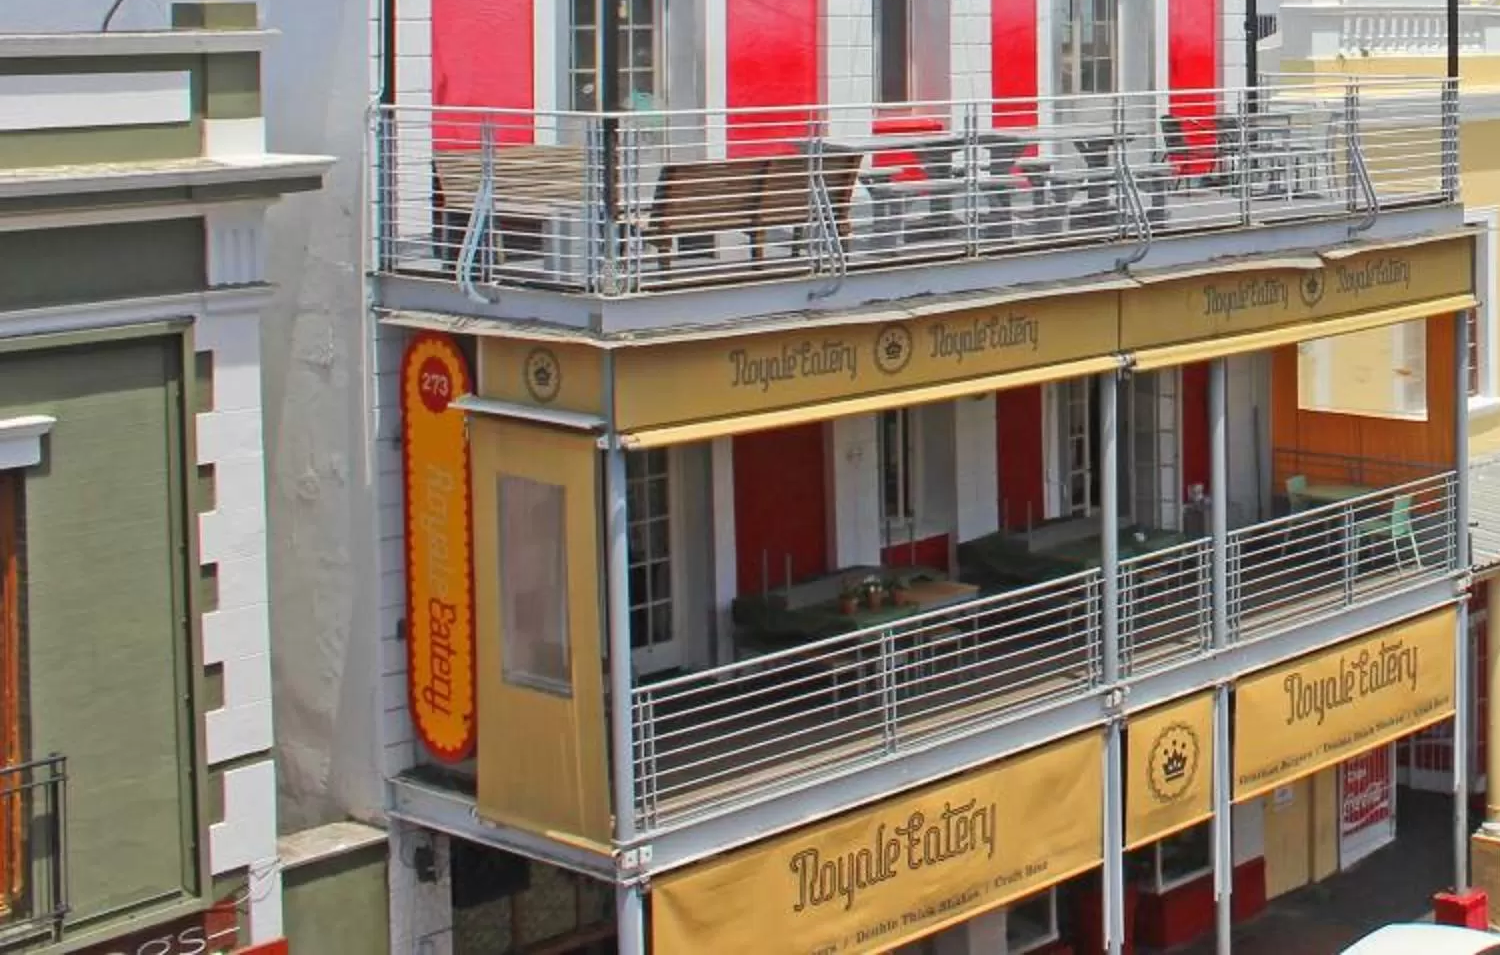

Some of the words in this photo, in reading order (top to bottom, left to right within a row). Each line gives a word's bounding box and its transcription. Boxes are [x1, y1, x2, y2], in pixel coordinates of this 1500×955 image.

[729, 345, 796, 391] Royale
[794, 336, 857, 379] Eatery
[930, 318, 987, 364] Royale
[983, 313, 1039, 352] Eatery
[422, 372, 449, 397] 273
[422, 597, 457, 714] Eatery
[1283, 655, 1355, 725] Royale
[1351, 639, 1418, 697] Eatery
[789, 823, 900, 912] Royale
[895, 798, 996, 870] Eatery
